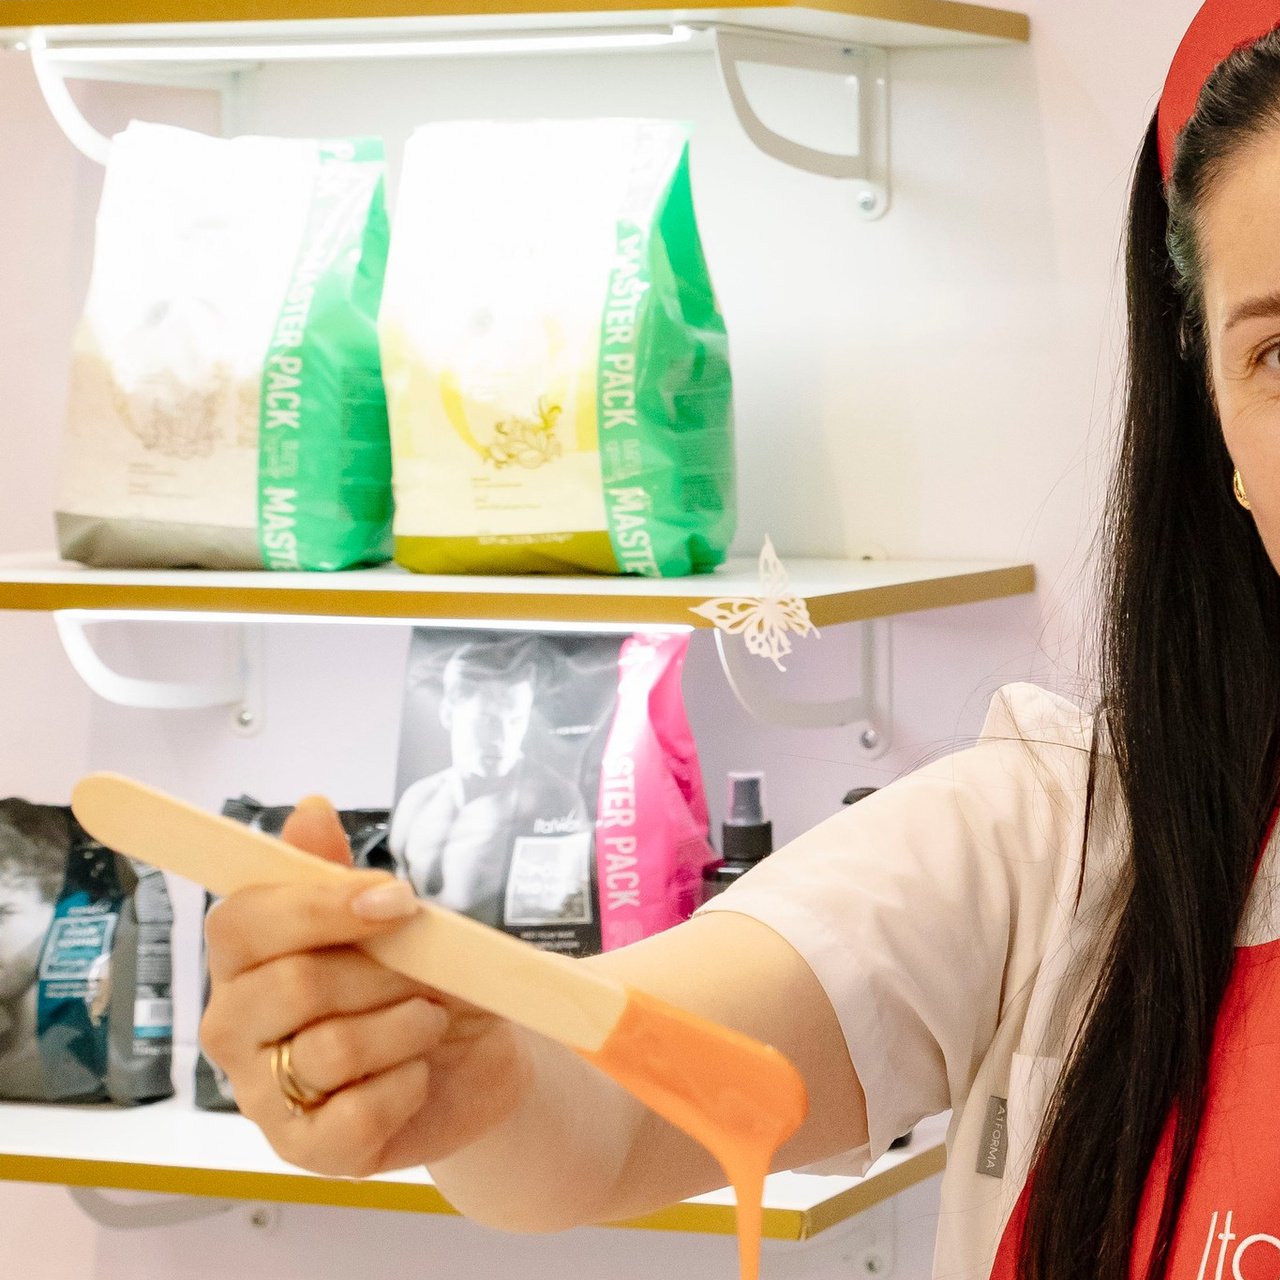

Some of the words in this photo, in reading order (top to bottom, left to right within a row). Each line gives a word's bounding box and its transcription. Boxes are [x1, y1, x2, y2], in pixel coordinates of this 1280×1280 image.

[606, 234, 641, 346] MASTER
[265, 354, 302, 429] PACK
[603, 353, 637, 429] PACK
[604, 836, 641, 911] PACK
